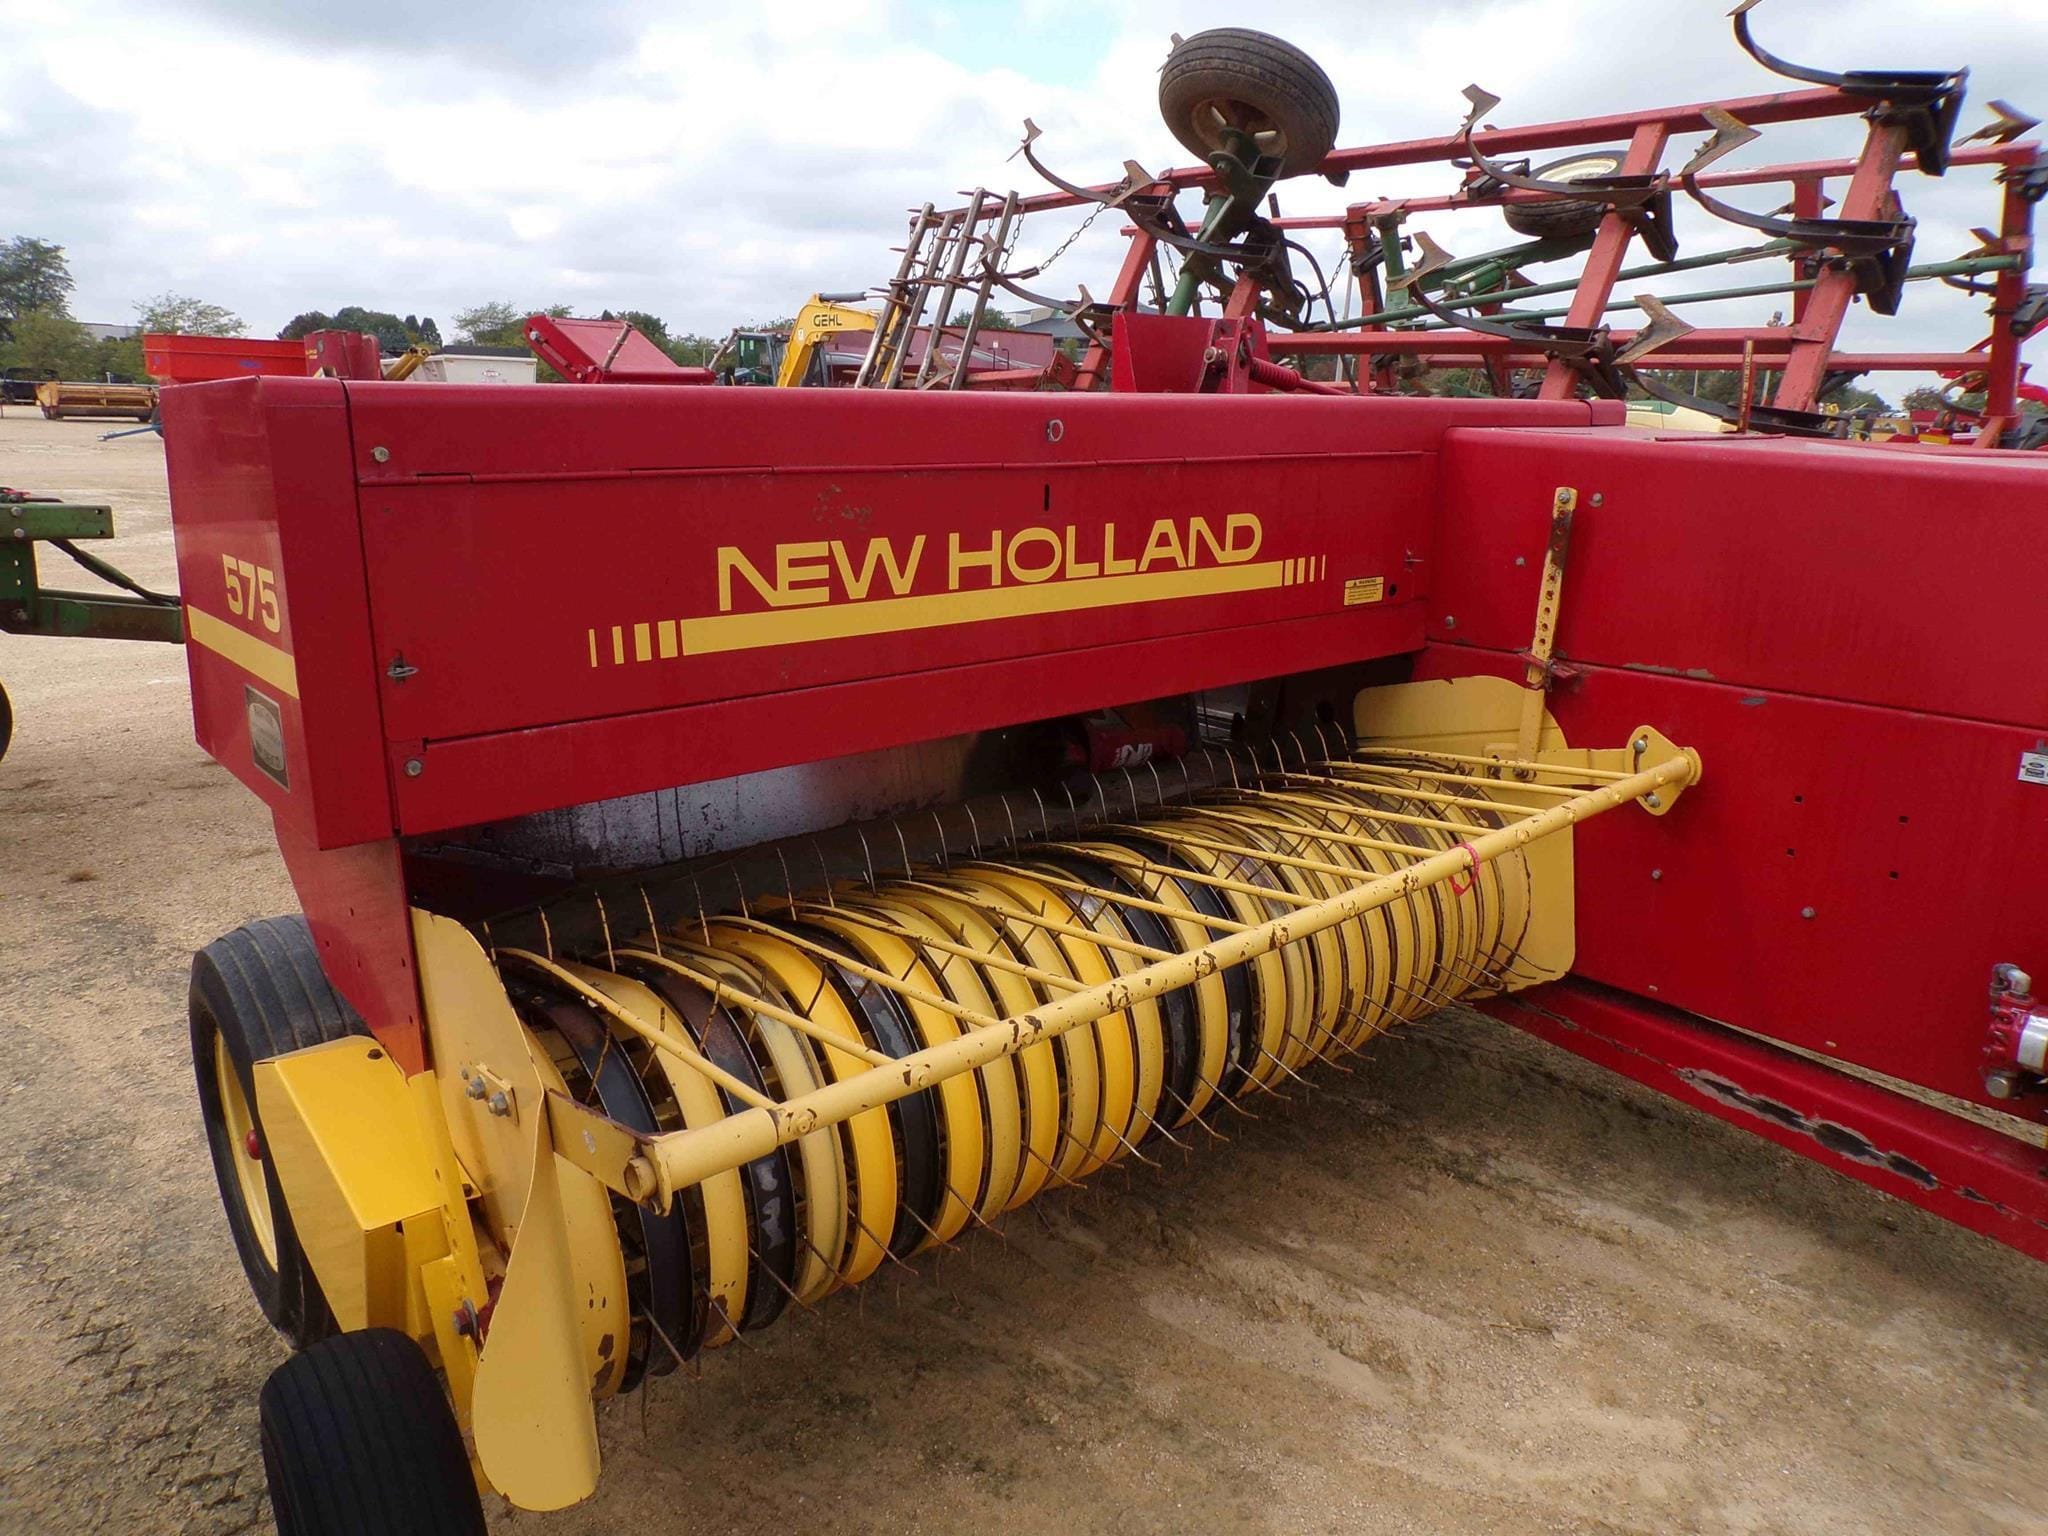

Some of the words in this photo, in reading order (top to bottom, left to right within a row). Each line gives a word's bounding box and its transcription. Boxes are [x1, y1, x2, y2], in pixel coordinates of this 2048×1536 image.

[813, 314, 843, 327] GEHL
[221, 553, 281, 634] 575
[717, 534, 926, 612] NEW
[948, 513, 1263, 590] HOLLAND
